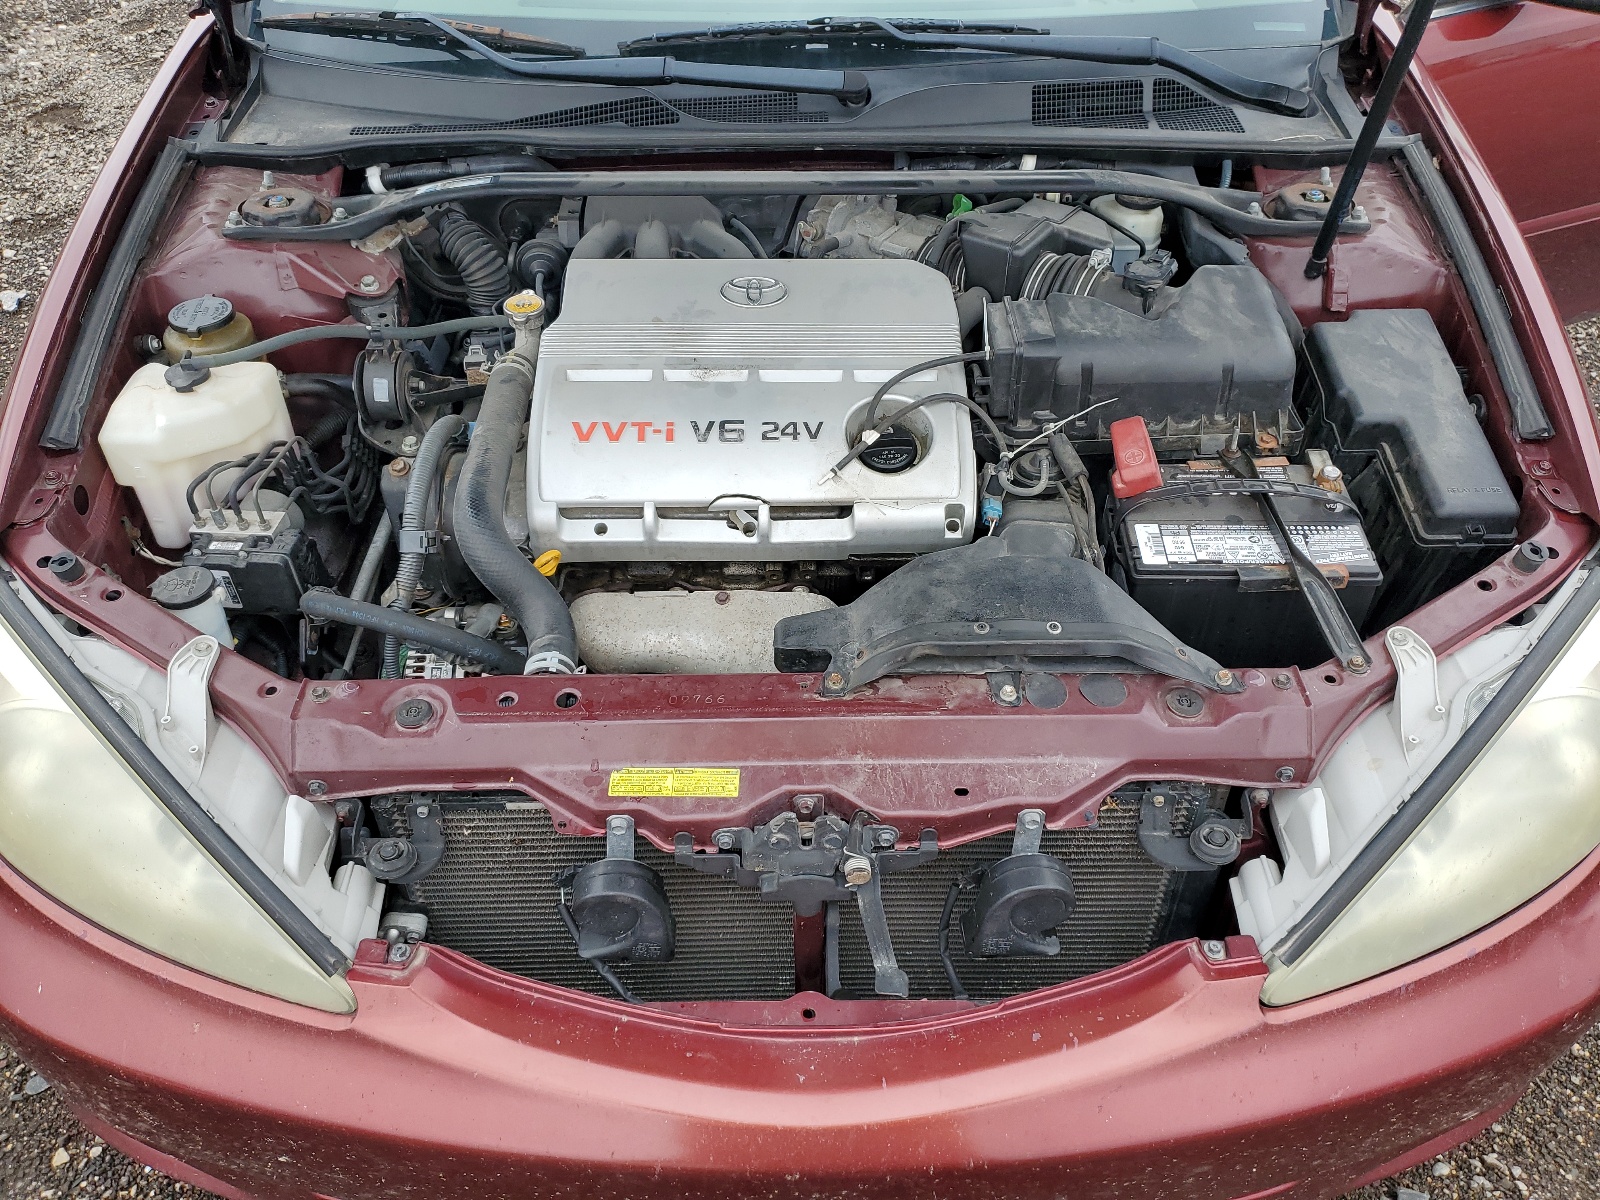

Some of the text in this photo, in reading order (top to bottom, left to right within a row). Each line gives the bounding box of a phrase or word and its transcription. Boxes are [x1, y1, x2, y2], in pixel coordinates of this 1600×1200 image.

[572, 419, 825, 444] VVT-i V6 24V
[668, 694, 726, 705] 09766
